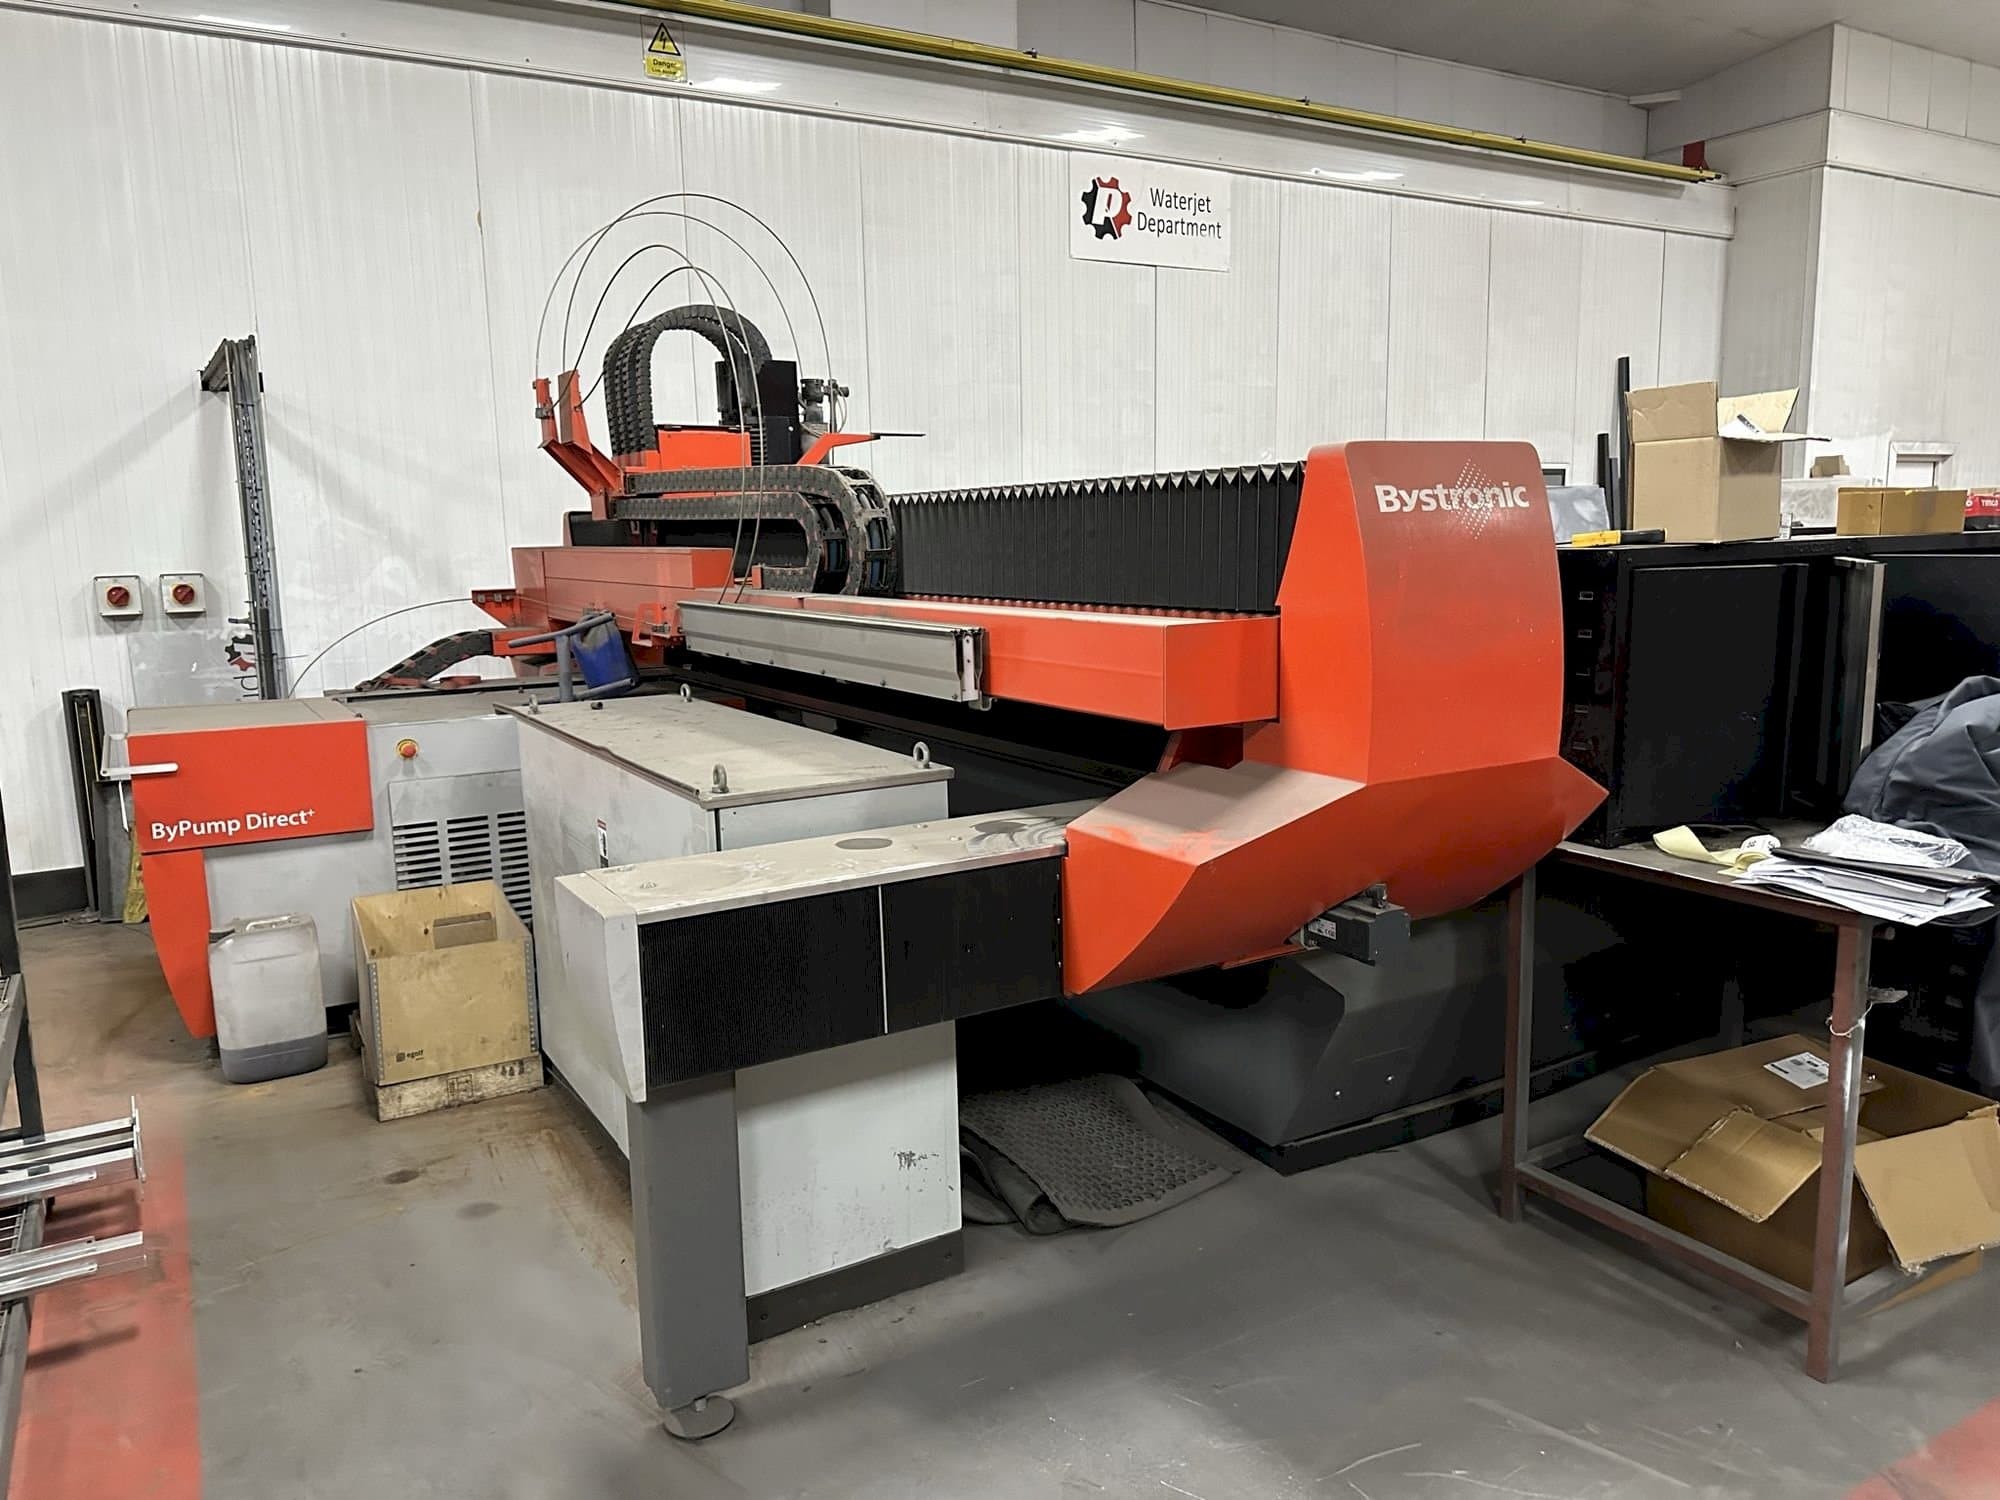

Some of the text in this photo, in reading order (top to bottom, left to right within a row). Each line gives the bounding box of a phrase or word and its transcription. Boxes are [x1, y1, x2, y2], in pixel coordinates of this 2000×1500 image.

[1149, 187, 1212, 217] Waterjet
[1137, 211, 1222, 240] Department
[1374, 481, 1530, 513] Bystronic
[150, 818, 241, 843] ByPump
